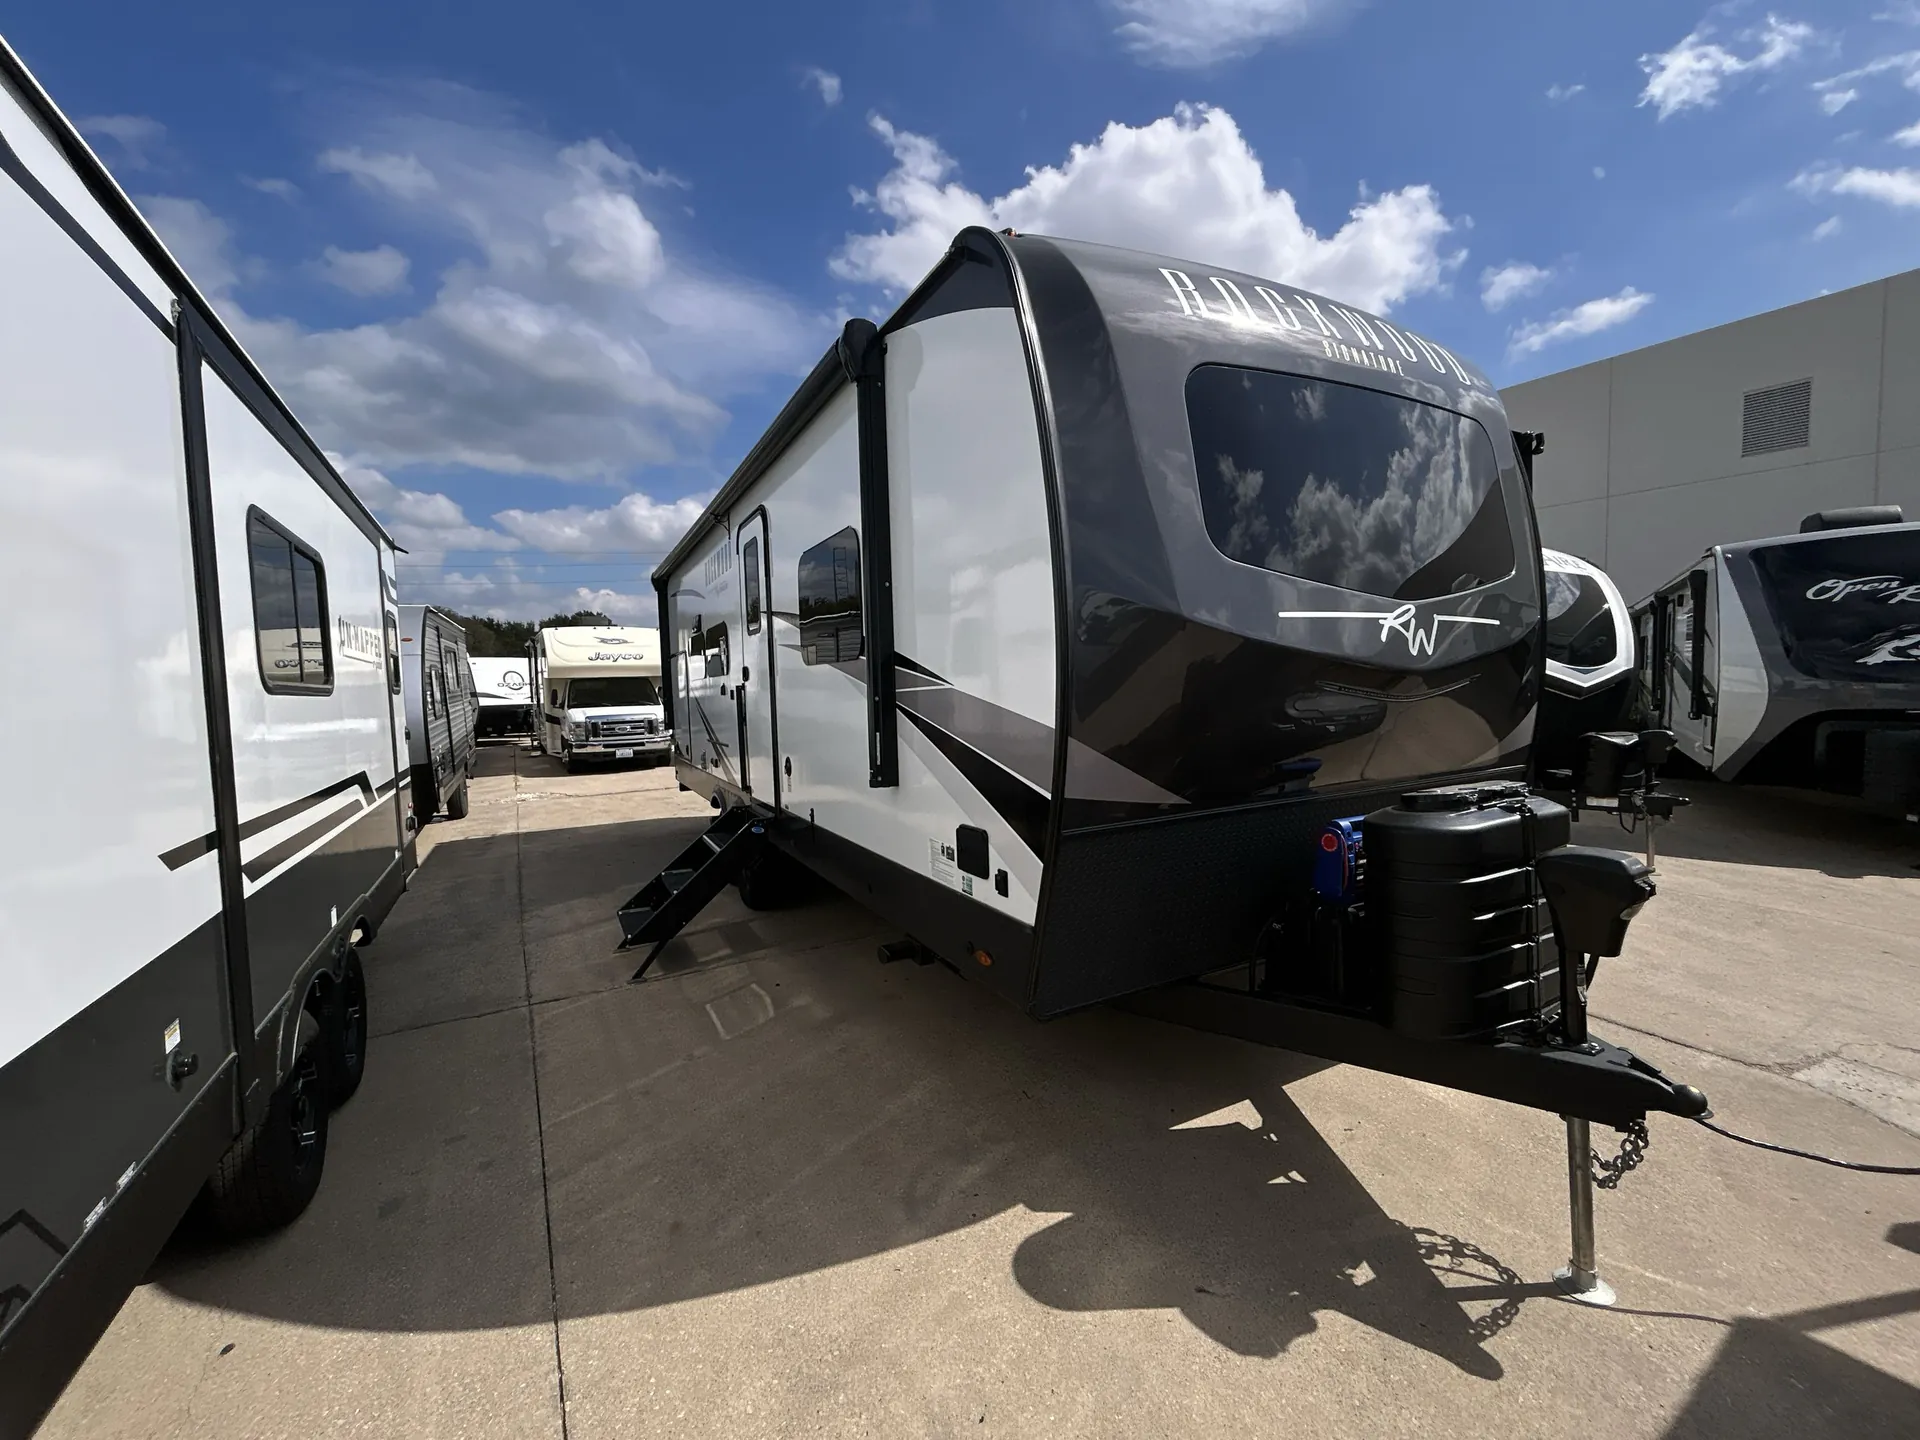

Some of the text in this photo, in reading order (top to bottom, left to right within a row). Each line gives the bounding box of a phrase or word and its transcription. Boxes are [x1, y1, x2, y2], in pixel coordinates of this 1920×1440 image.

[1158, 268, 1471, 385] ROCKWOOD
[1322, 340, 1404, 376] SIGNATURE
[1806, 575, 1904, 602] Open
[588, 652, 644, 662] Jayco
